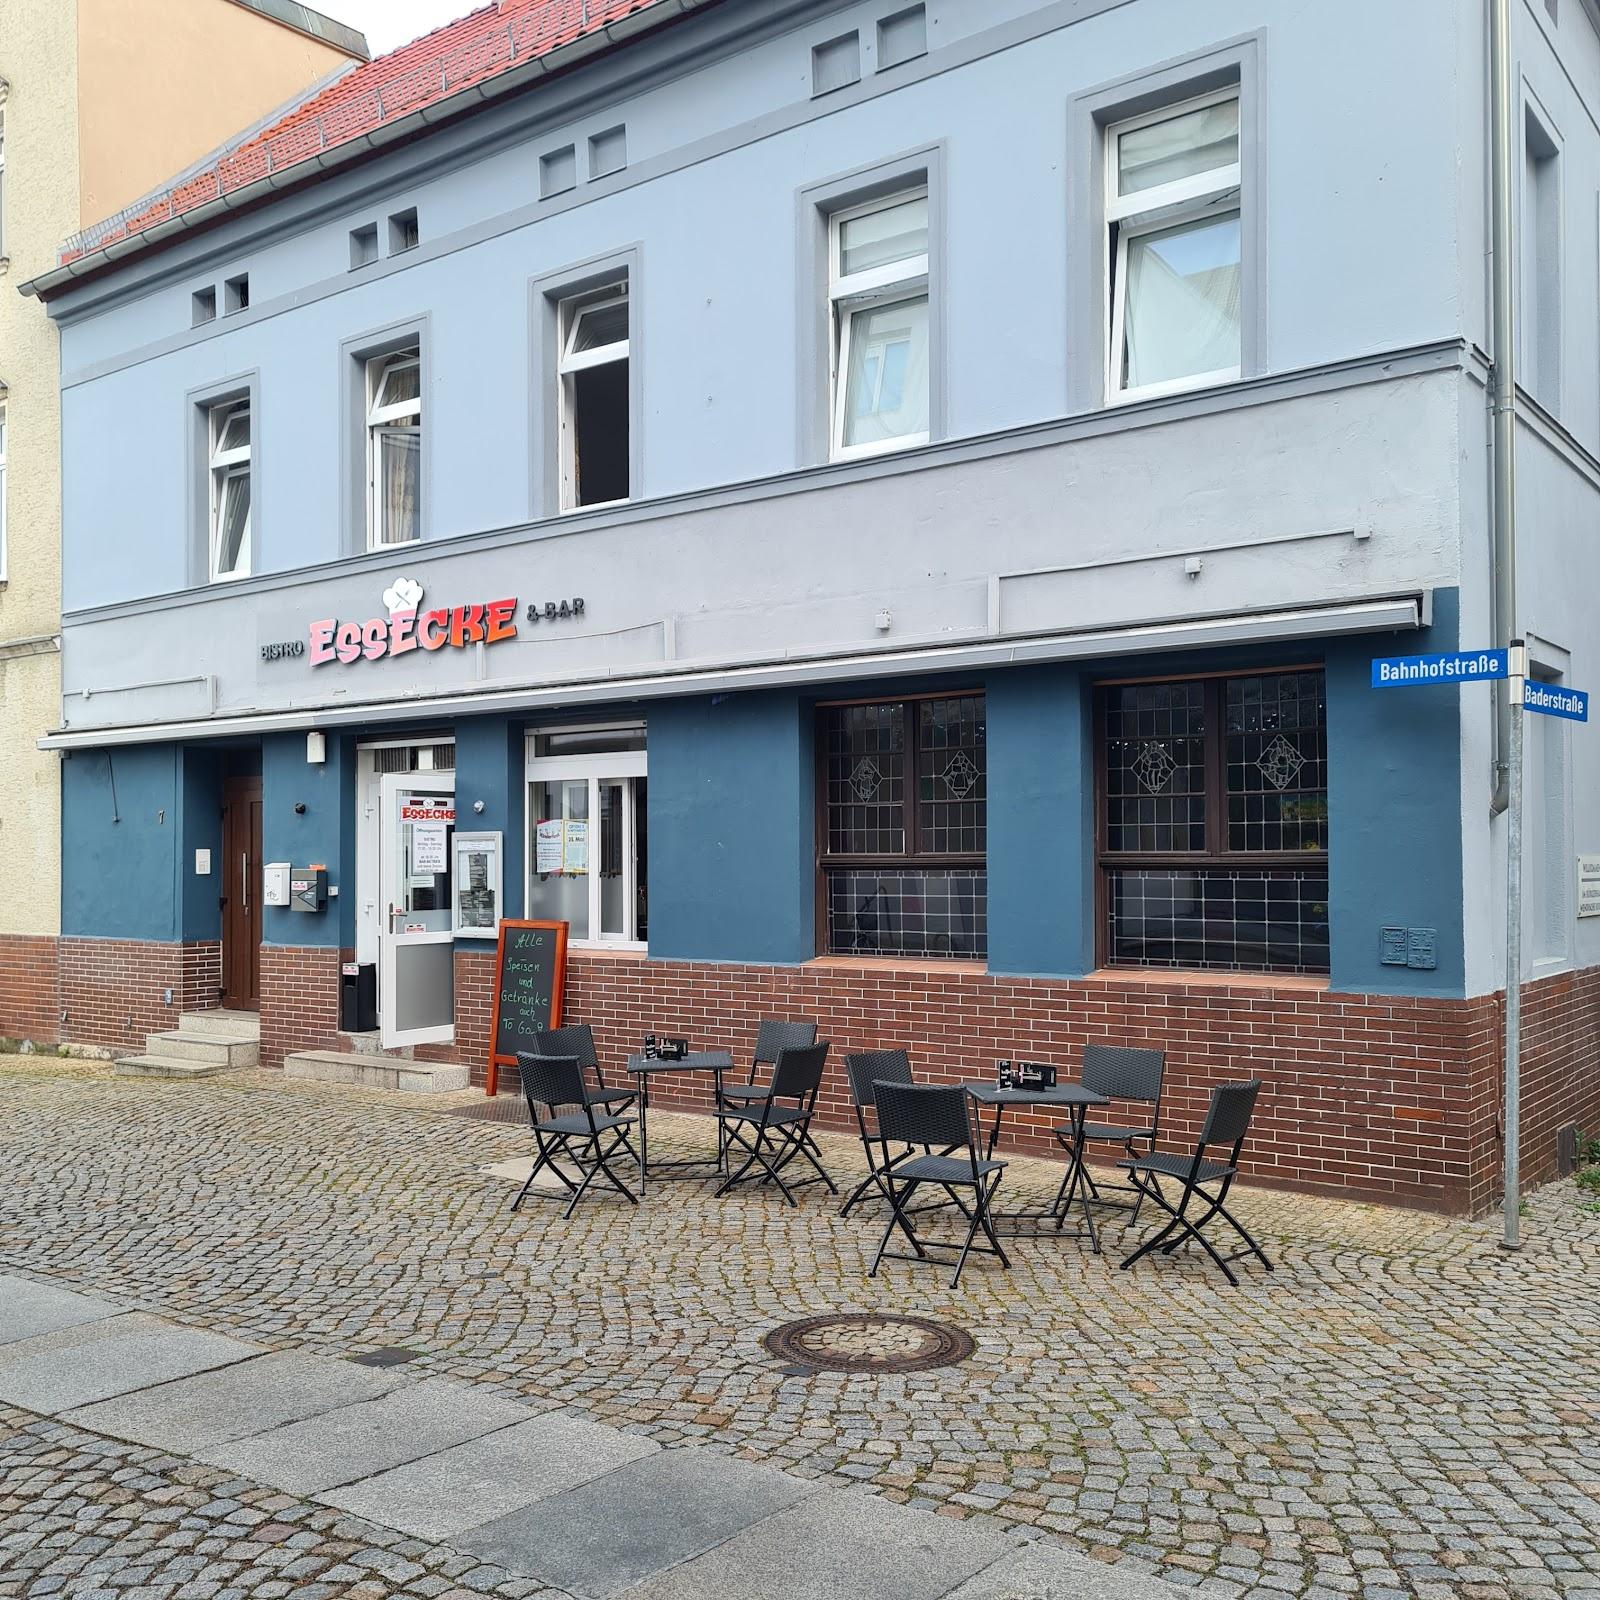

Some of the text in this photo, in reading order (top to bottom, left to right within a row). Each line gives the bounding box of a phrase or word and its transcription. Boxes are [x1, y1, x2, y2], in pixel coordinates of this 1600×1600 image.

[260, 597, 585, 668] BISTRO ESSECKE & BAR
[1380, 655, 1499, 681] Bahnhofstraße
[1525, 685, 1584, 714] Baderstraße
[515, 934, 543, 948] Alle
[506, 957, 540, 972] Speisen
[519, 978, 533, 988] und
[501, 990, 549, 1007] Getränke
[520, 1007, 536, 1021] auch
[503, 1018, 514, 1030] To
